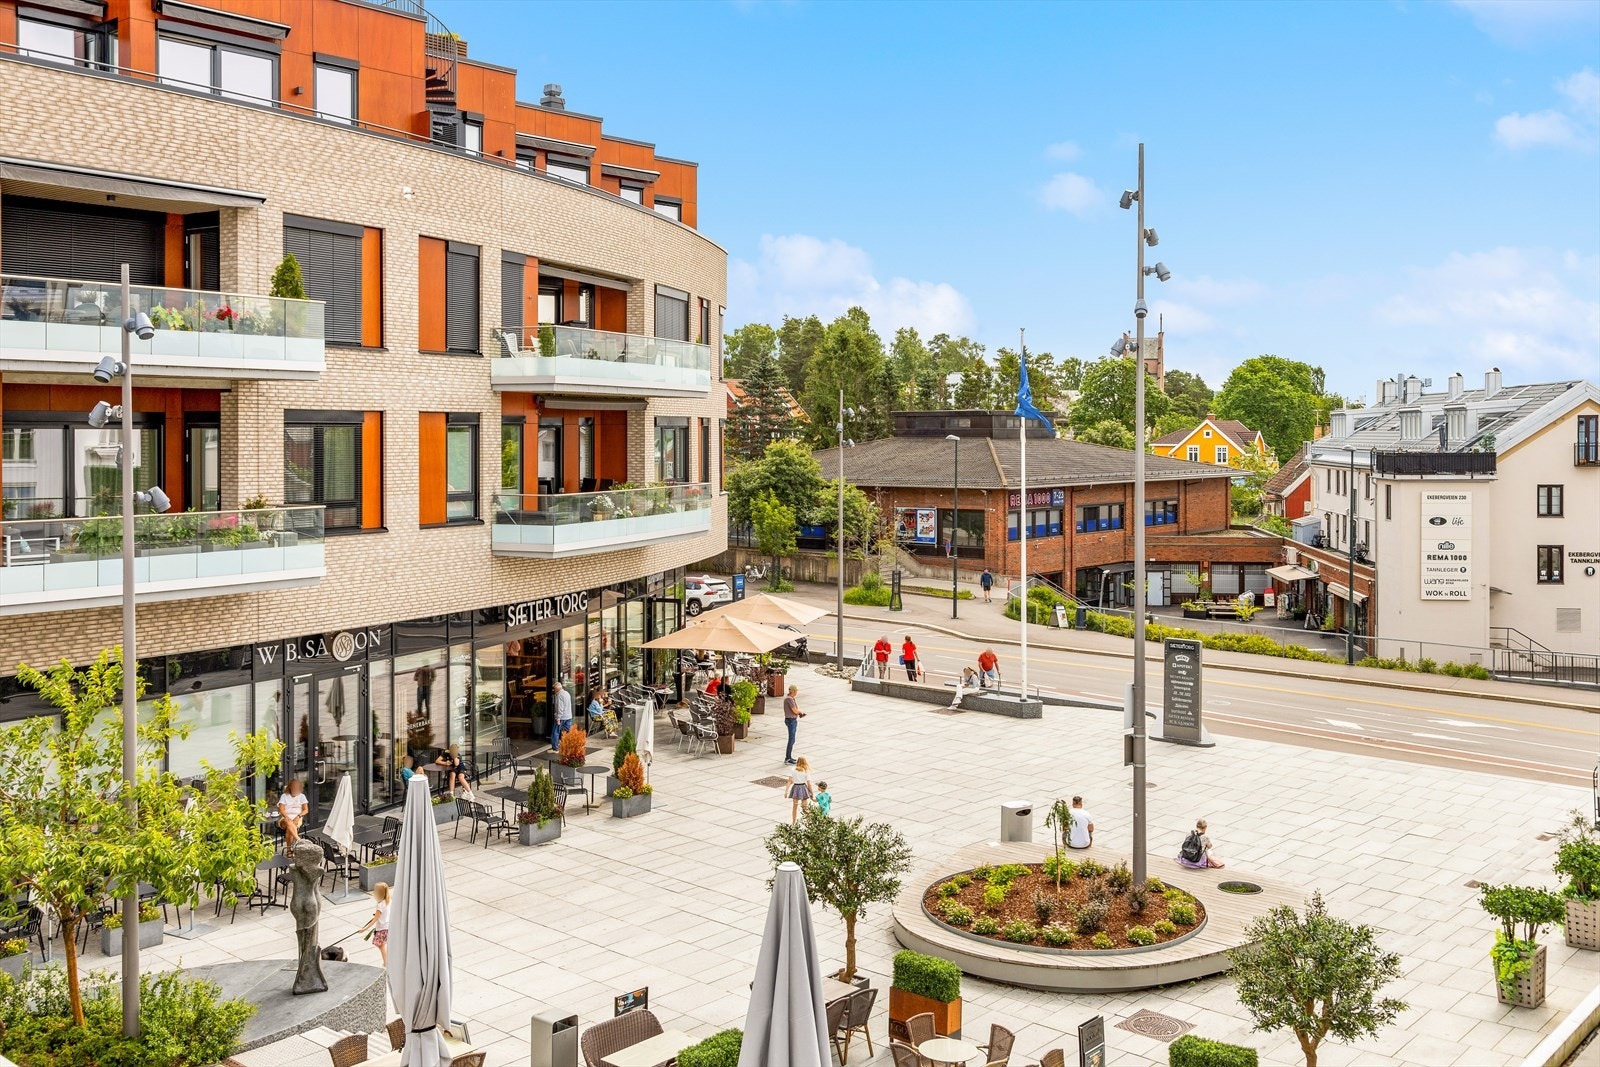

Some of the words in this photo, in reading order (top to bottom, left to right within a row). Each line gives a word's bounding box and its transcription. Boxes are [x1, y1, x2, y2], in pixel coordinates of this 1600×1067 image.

[1010, 494, 1033, 506] REA
[1033, 492, 1051, 505] 1000
[1053, 491, 1064, 499] 7-23
[507, 598, 551, 627] SÆTER
[554, 591, 588, 616] TORG
